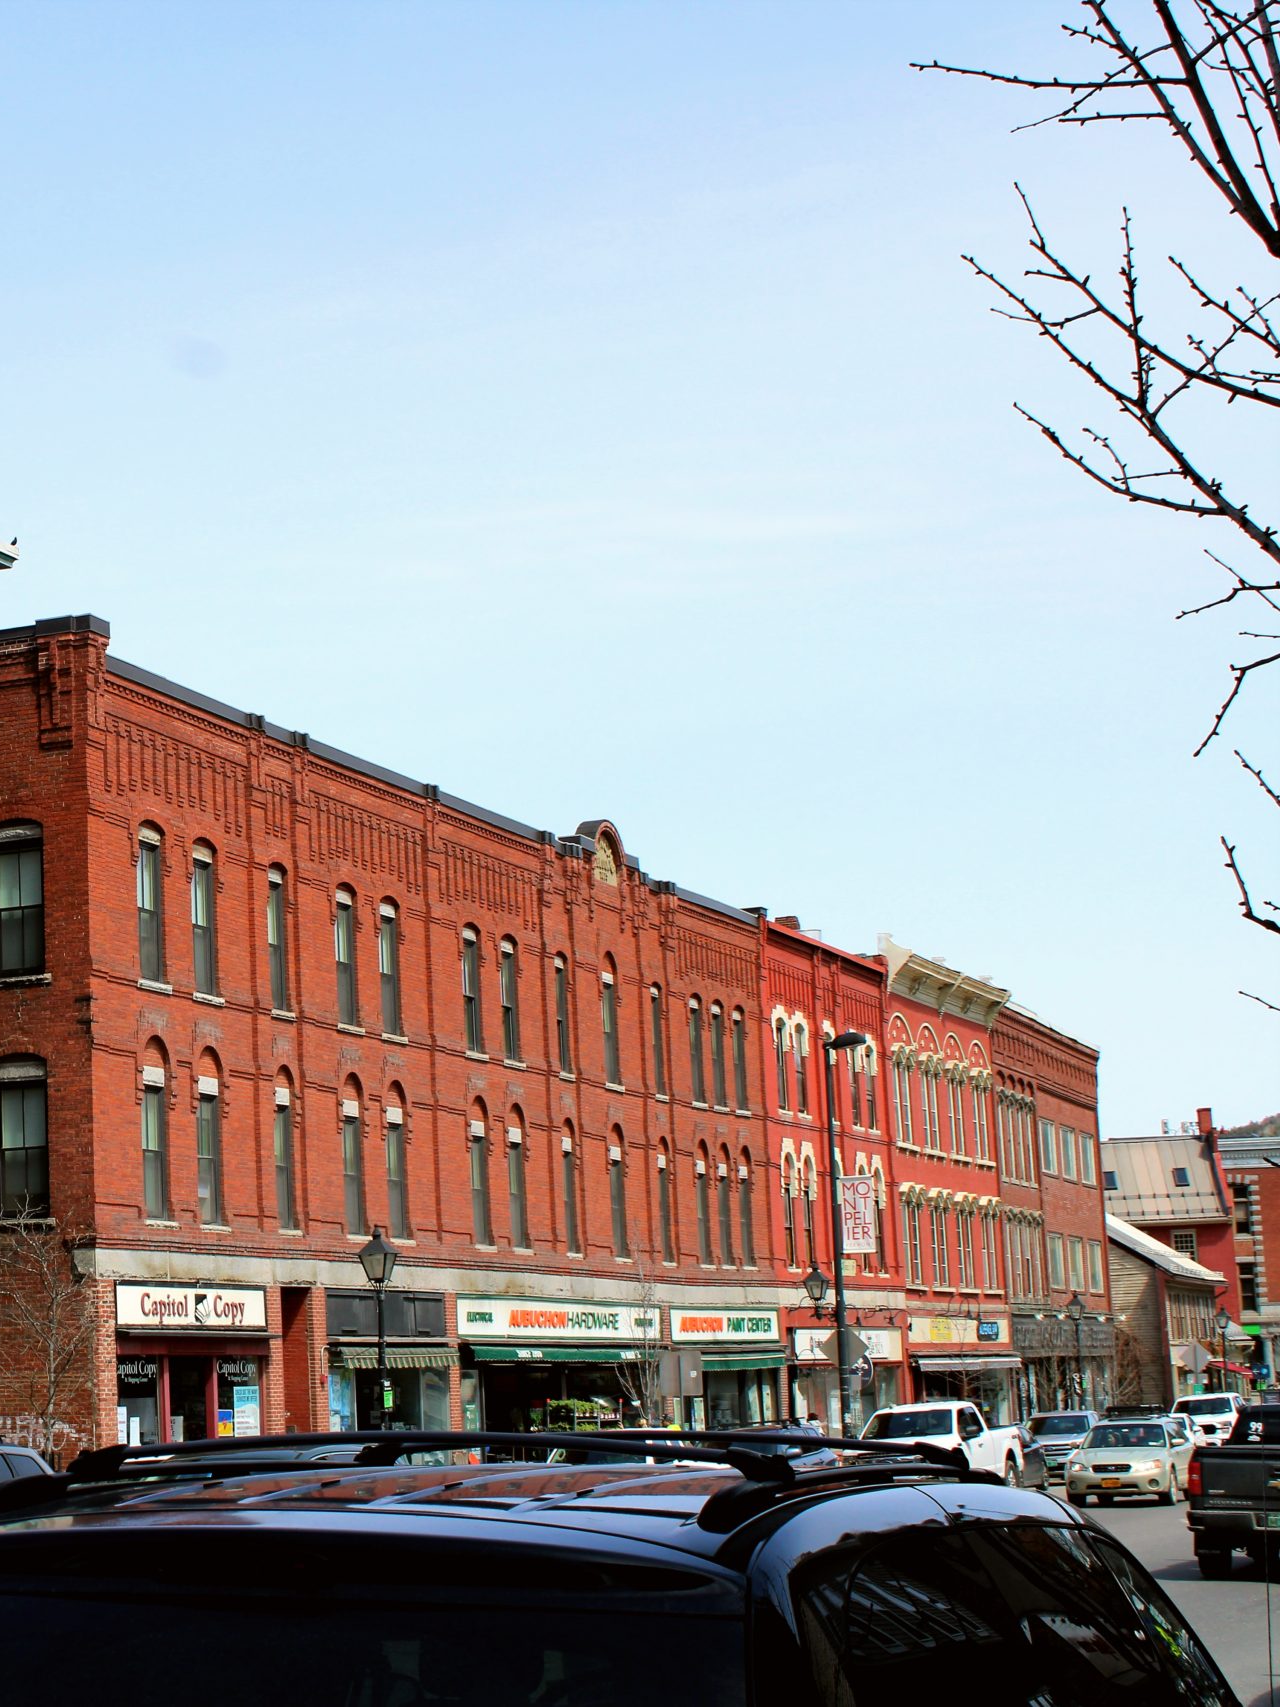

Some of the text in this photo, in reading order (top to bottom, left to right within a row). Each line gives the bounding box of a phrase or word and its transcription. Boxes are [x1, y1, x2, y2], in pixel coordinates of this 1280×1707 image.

[842, 1181, 870, 1196] MO
[843, 1196, 870, 1211] NT
[844, 1211, 872, 1226] PEL
[846, 1226, 872, 1240] IER
[140, 1292, 245, 1325] Capitol Copy
[509, 1310, 619, 1330] AUBUCHON HARDWARE
[680, 1316, 772, 1333] AUBUCHON PAINT CENTER
[116, 1360, 157, 1378] apitol Copy
[217, 1360, 256, 1377] Capitol Copy
